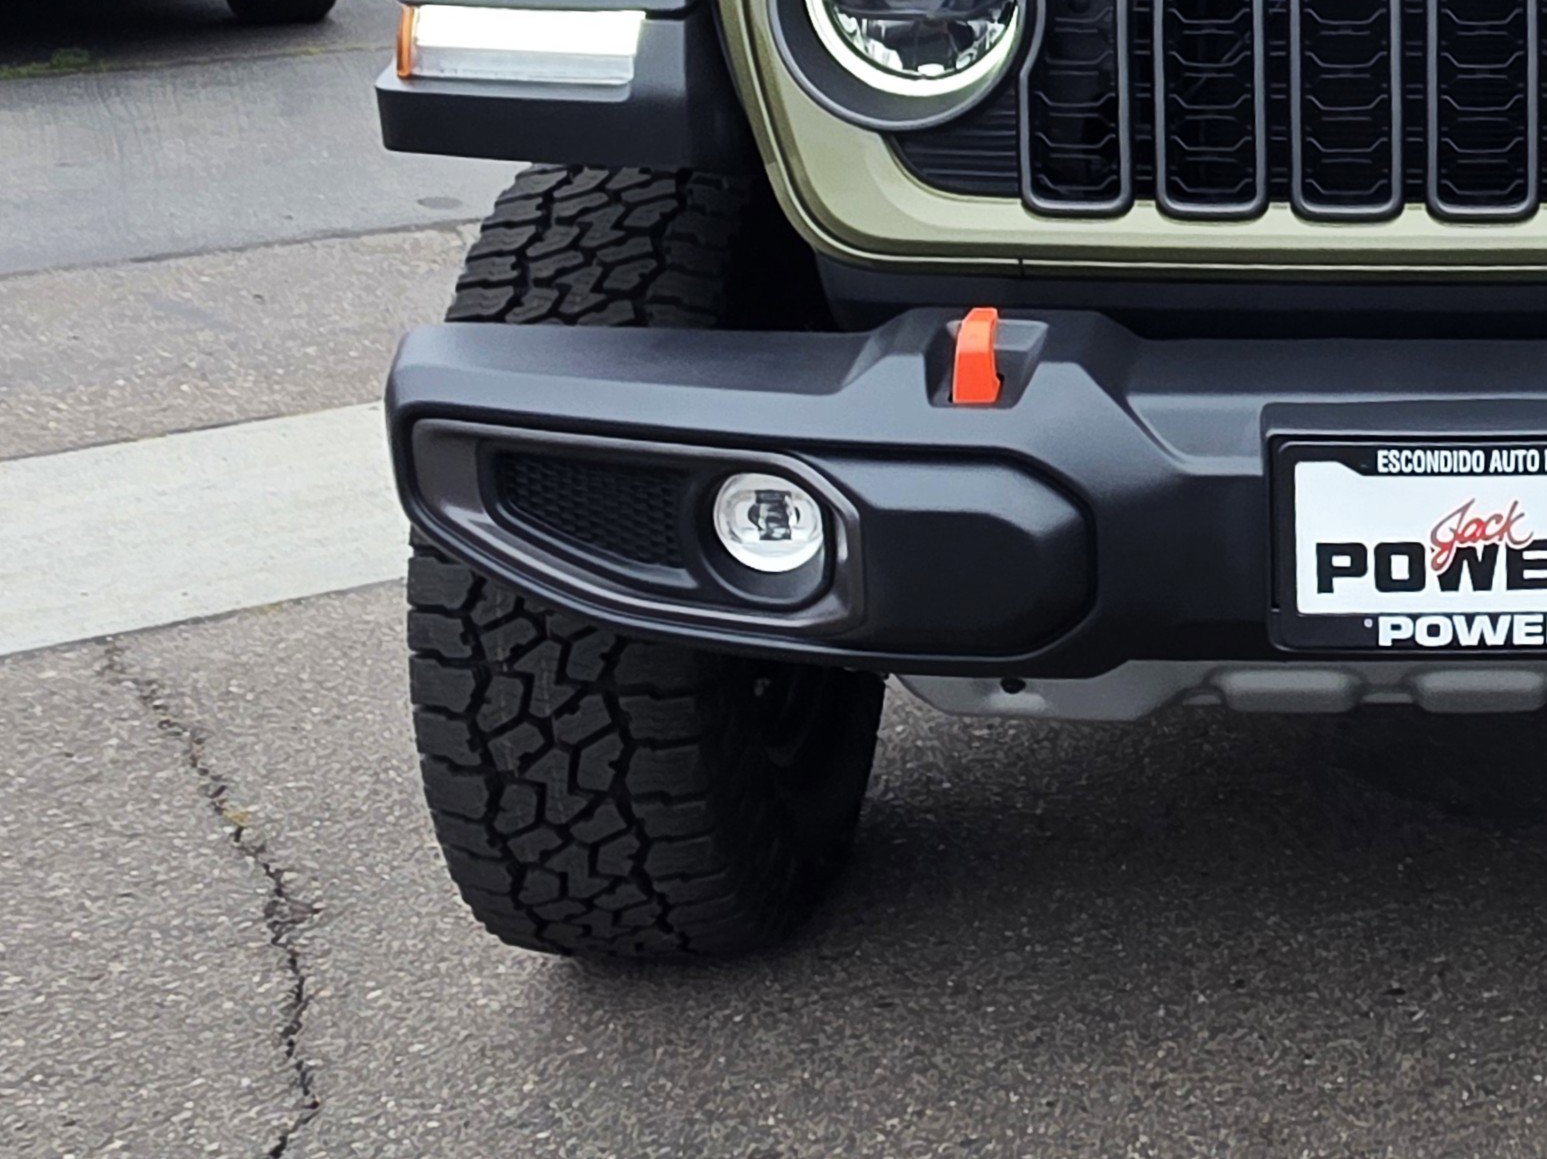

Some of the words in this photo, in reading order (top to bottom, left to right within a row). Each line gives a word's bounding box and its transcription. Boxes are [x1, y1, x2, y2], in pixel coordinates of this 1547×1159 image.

[1377, 449, 1485, 474] ESCONDIDO
[1488, 449, 1540, 473] AUTO
[1430, 498, 1534, 571] Jack
